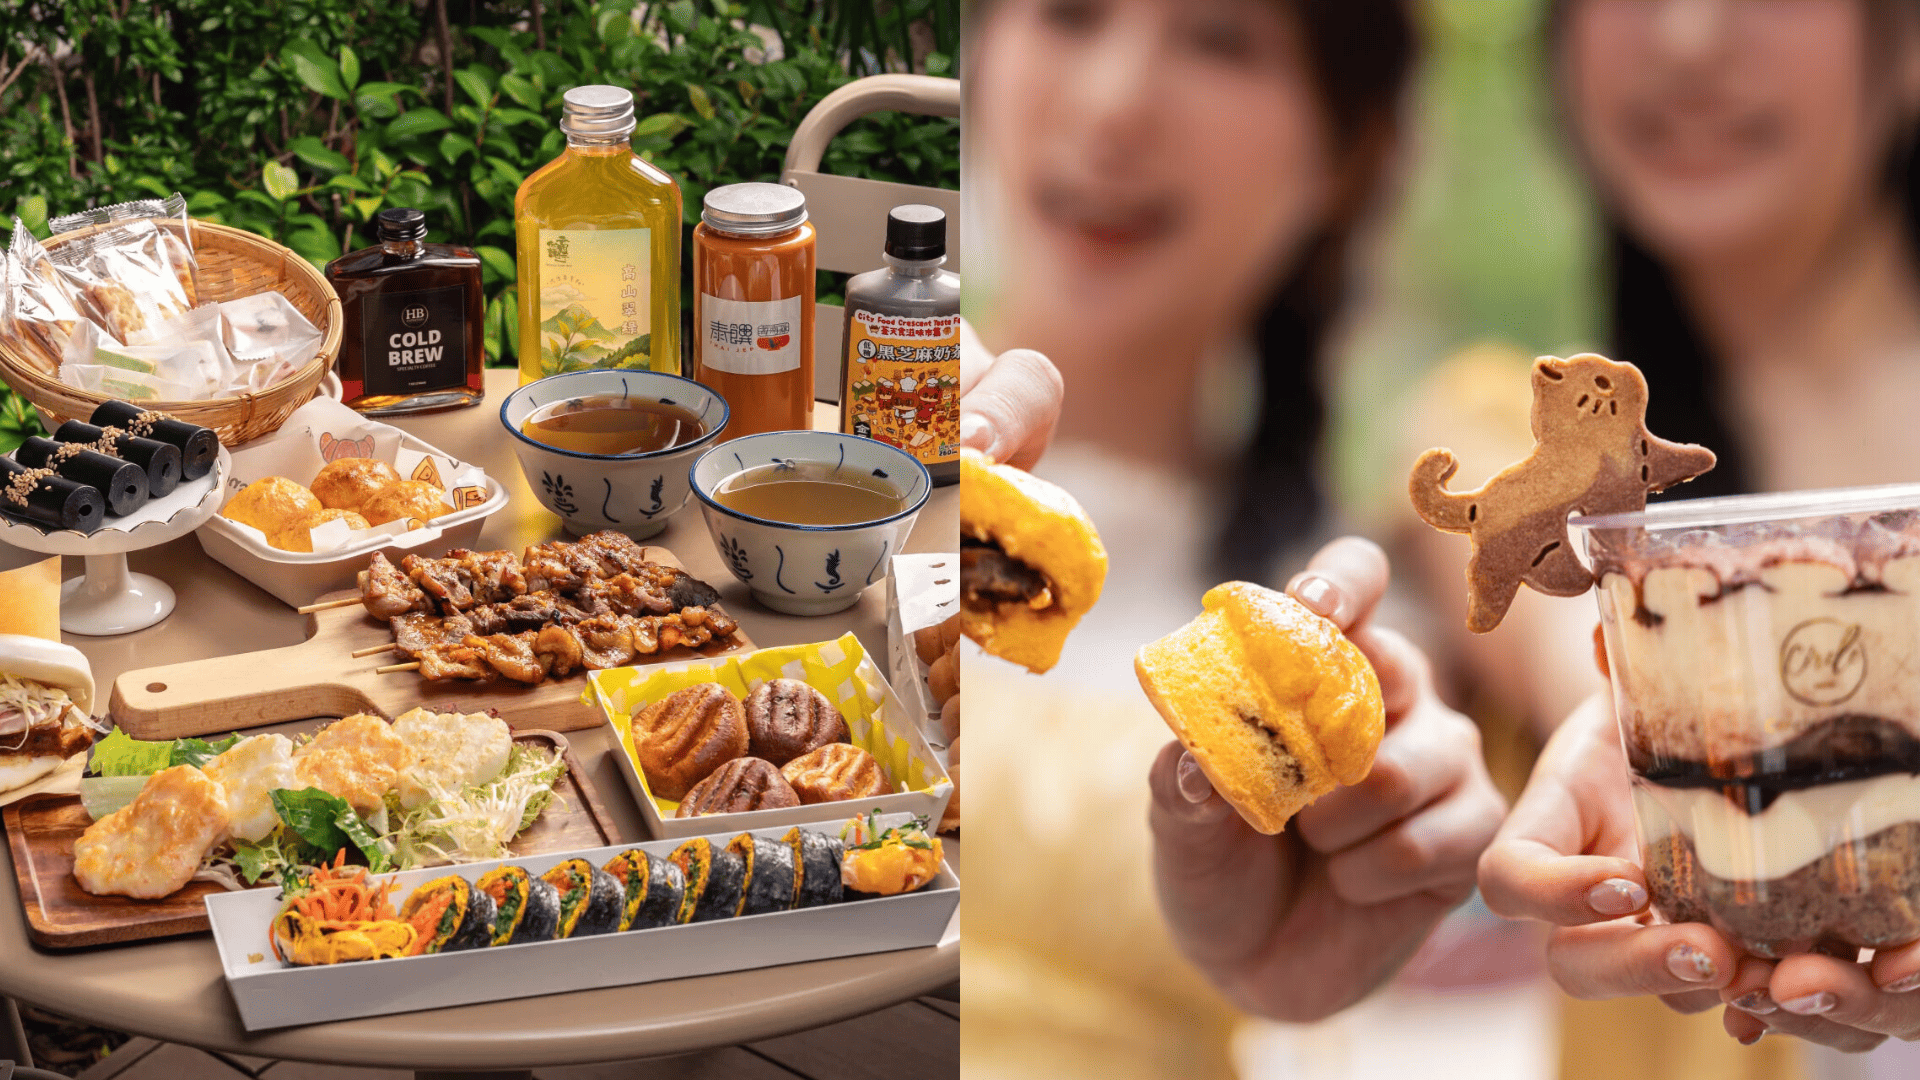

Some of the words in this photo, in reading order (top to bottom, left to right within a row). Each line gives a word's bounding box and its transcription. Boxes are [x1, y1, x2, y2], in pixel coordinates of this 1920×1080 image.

[621, 263, 638, 335] 高山翠綠
[406, 308, 425, 319] HB
[857, 312, 875, 322] City
[877, 316, 896, 325] Food
[898, 319, 932, 327] Crescent
[389, 330, 442, 348] COLD
[388, 346, 443, 366] BREW
